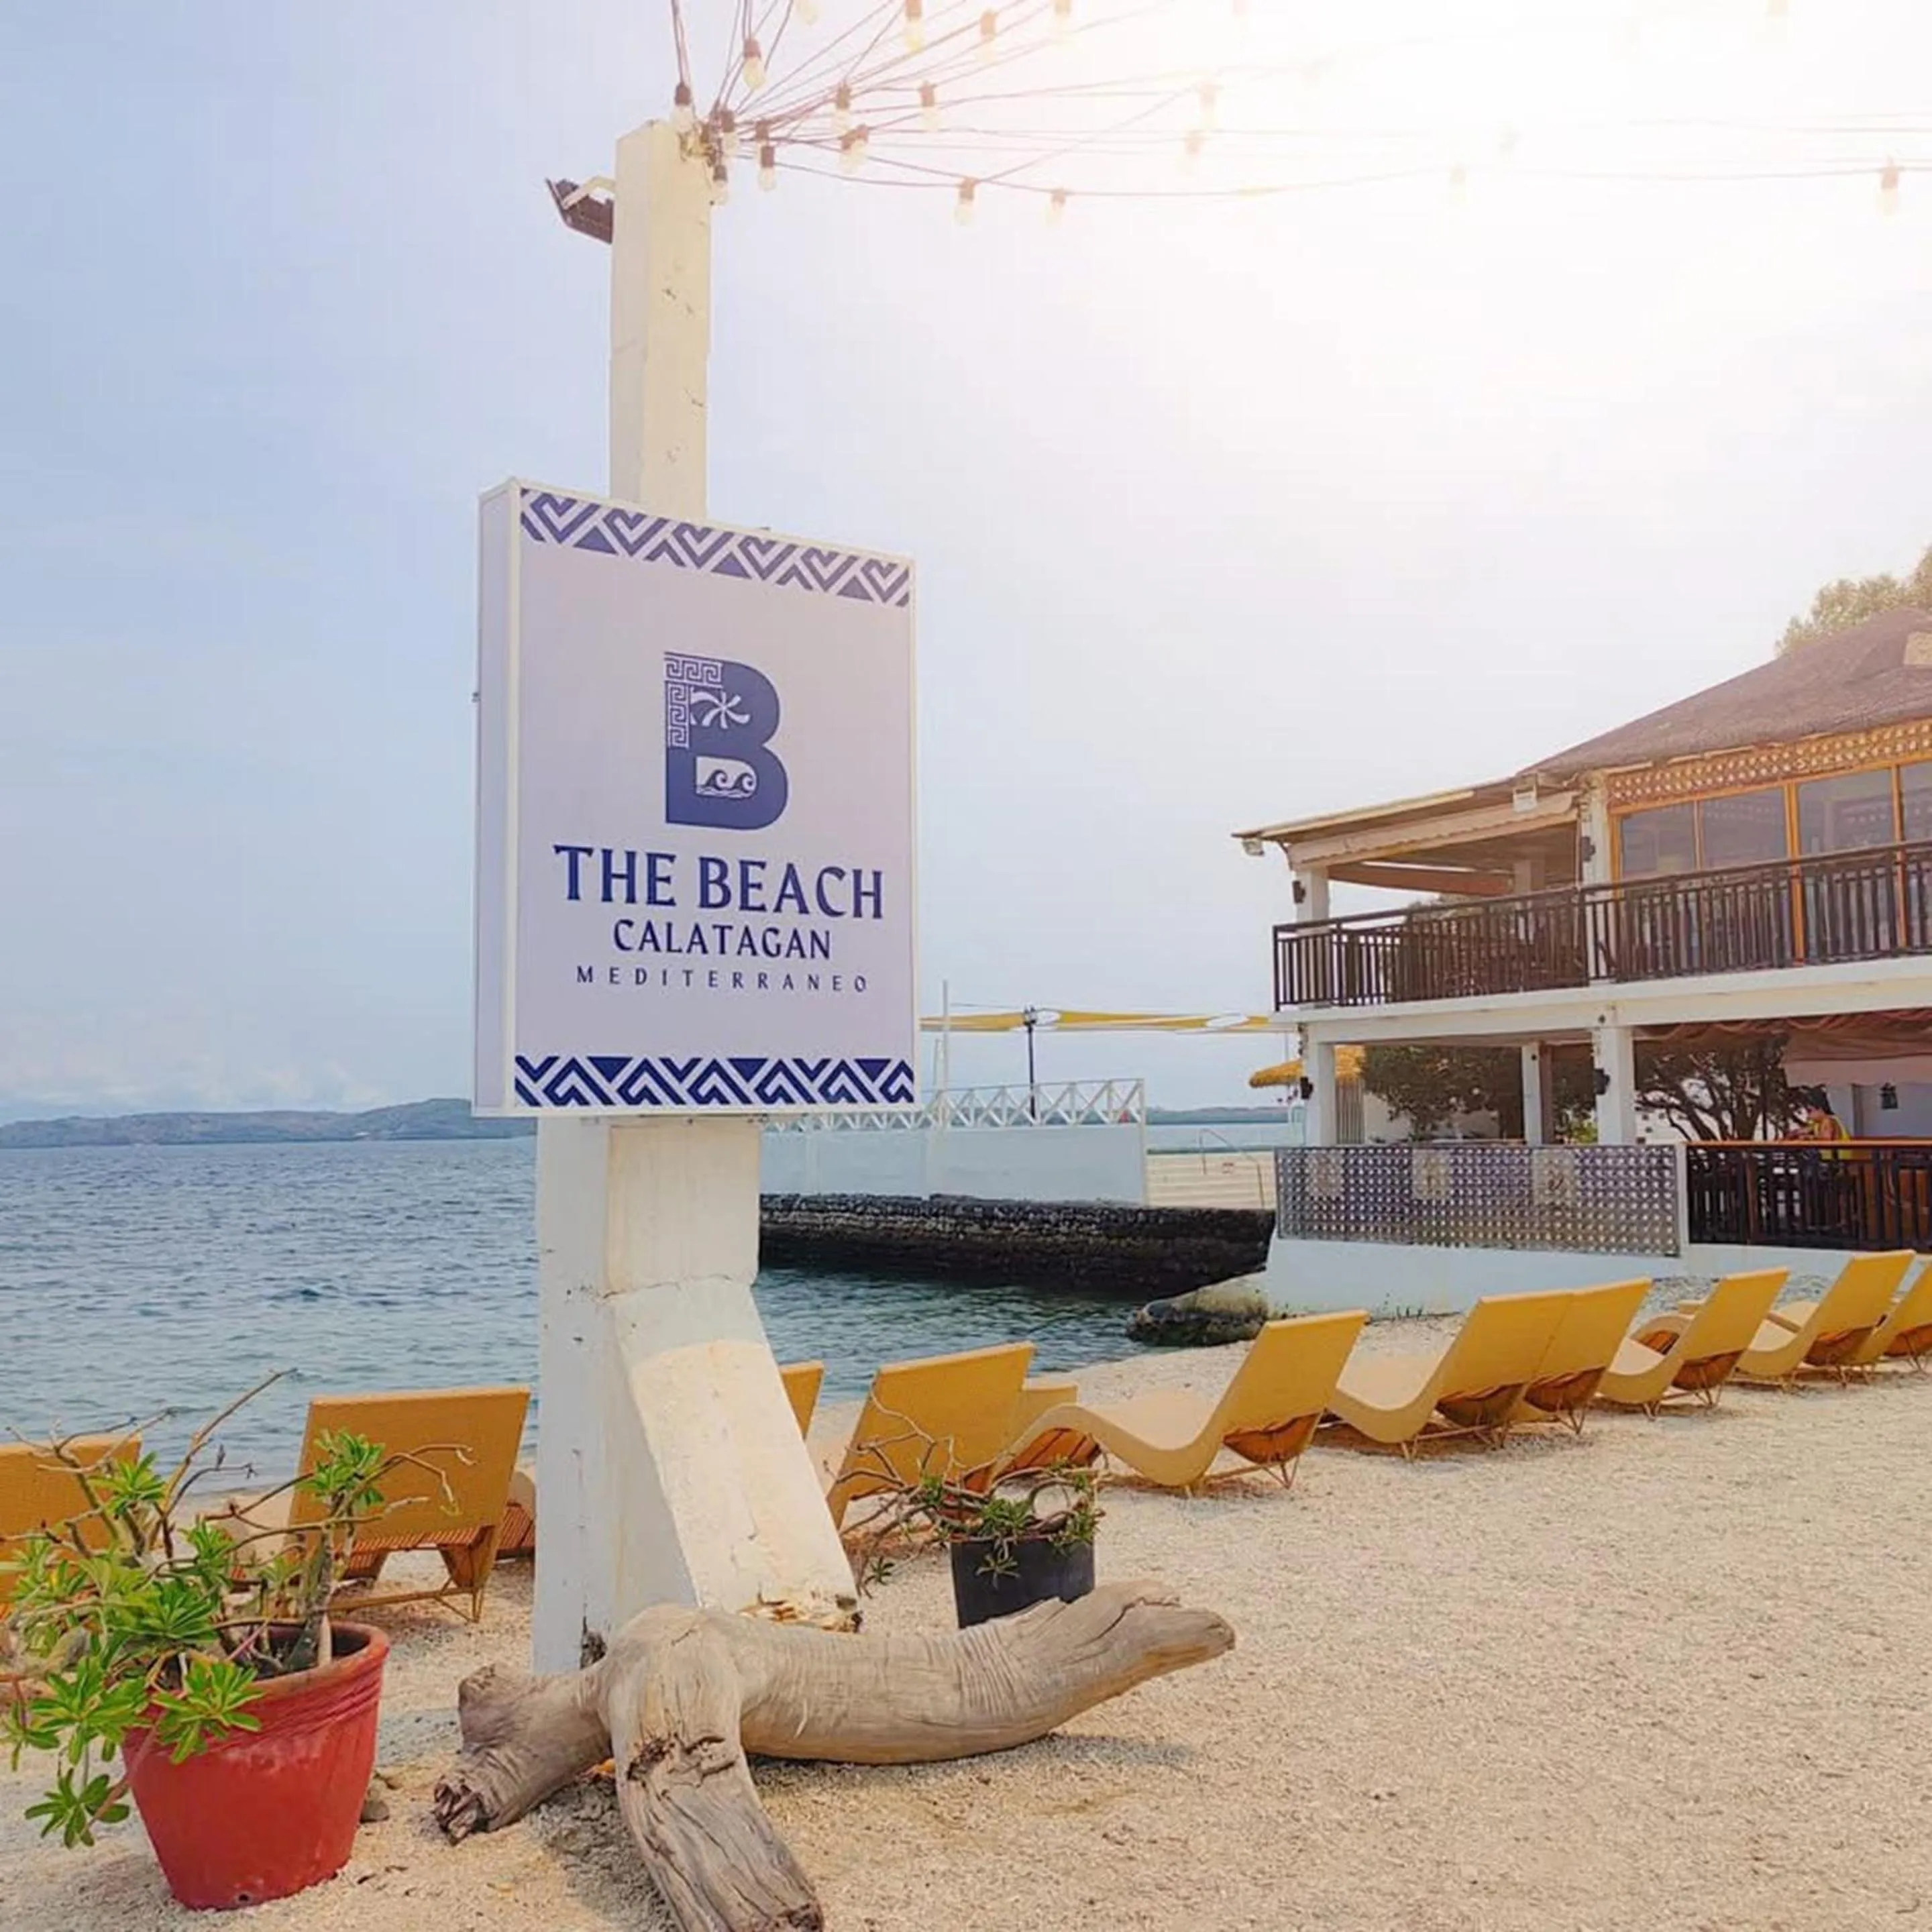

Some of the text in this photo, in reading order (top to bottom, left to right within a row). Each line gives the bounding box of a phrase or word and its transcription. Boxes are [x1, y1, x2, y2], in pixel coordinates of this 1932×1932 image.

[665, 651, 788, 831] B
[552, 843, 883, 921] THE BEACH
[612, 918, 832, 961] CALATAGAN
[576, 965, 869, 993] MEDITERRANEO
